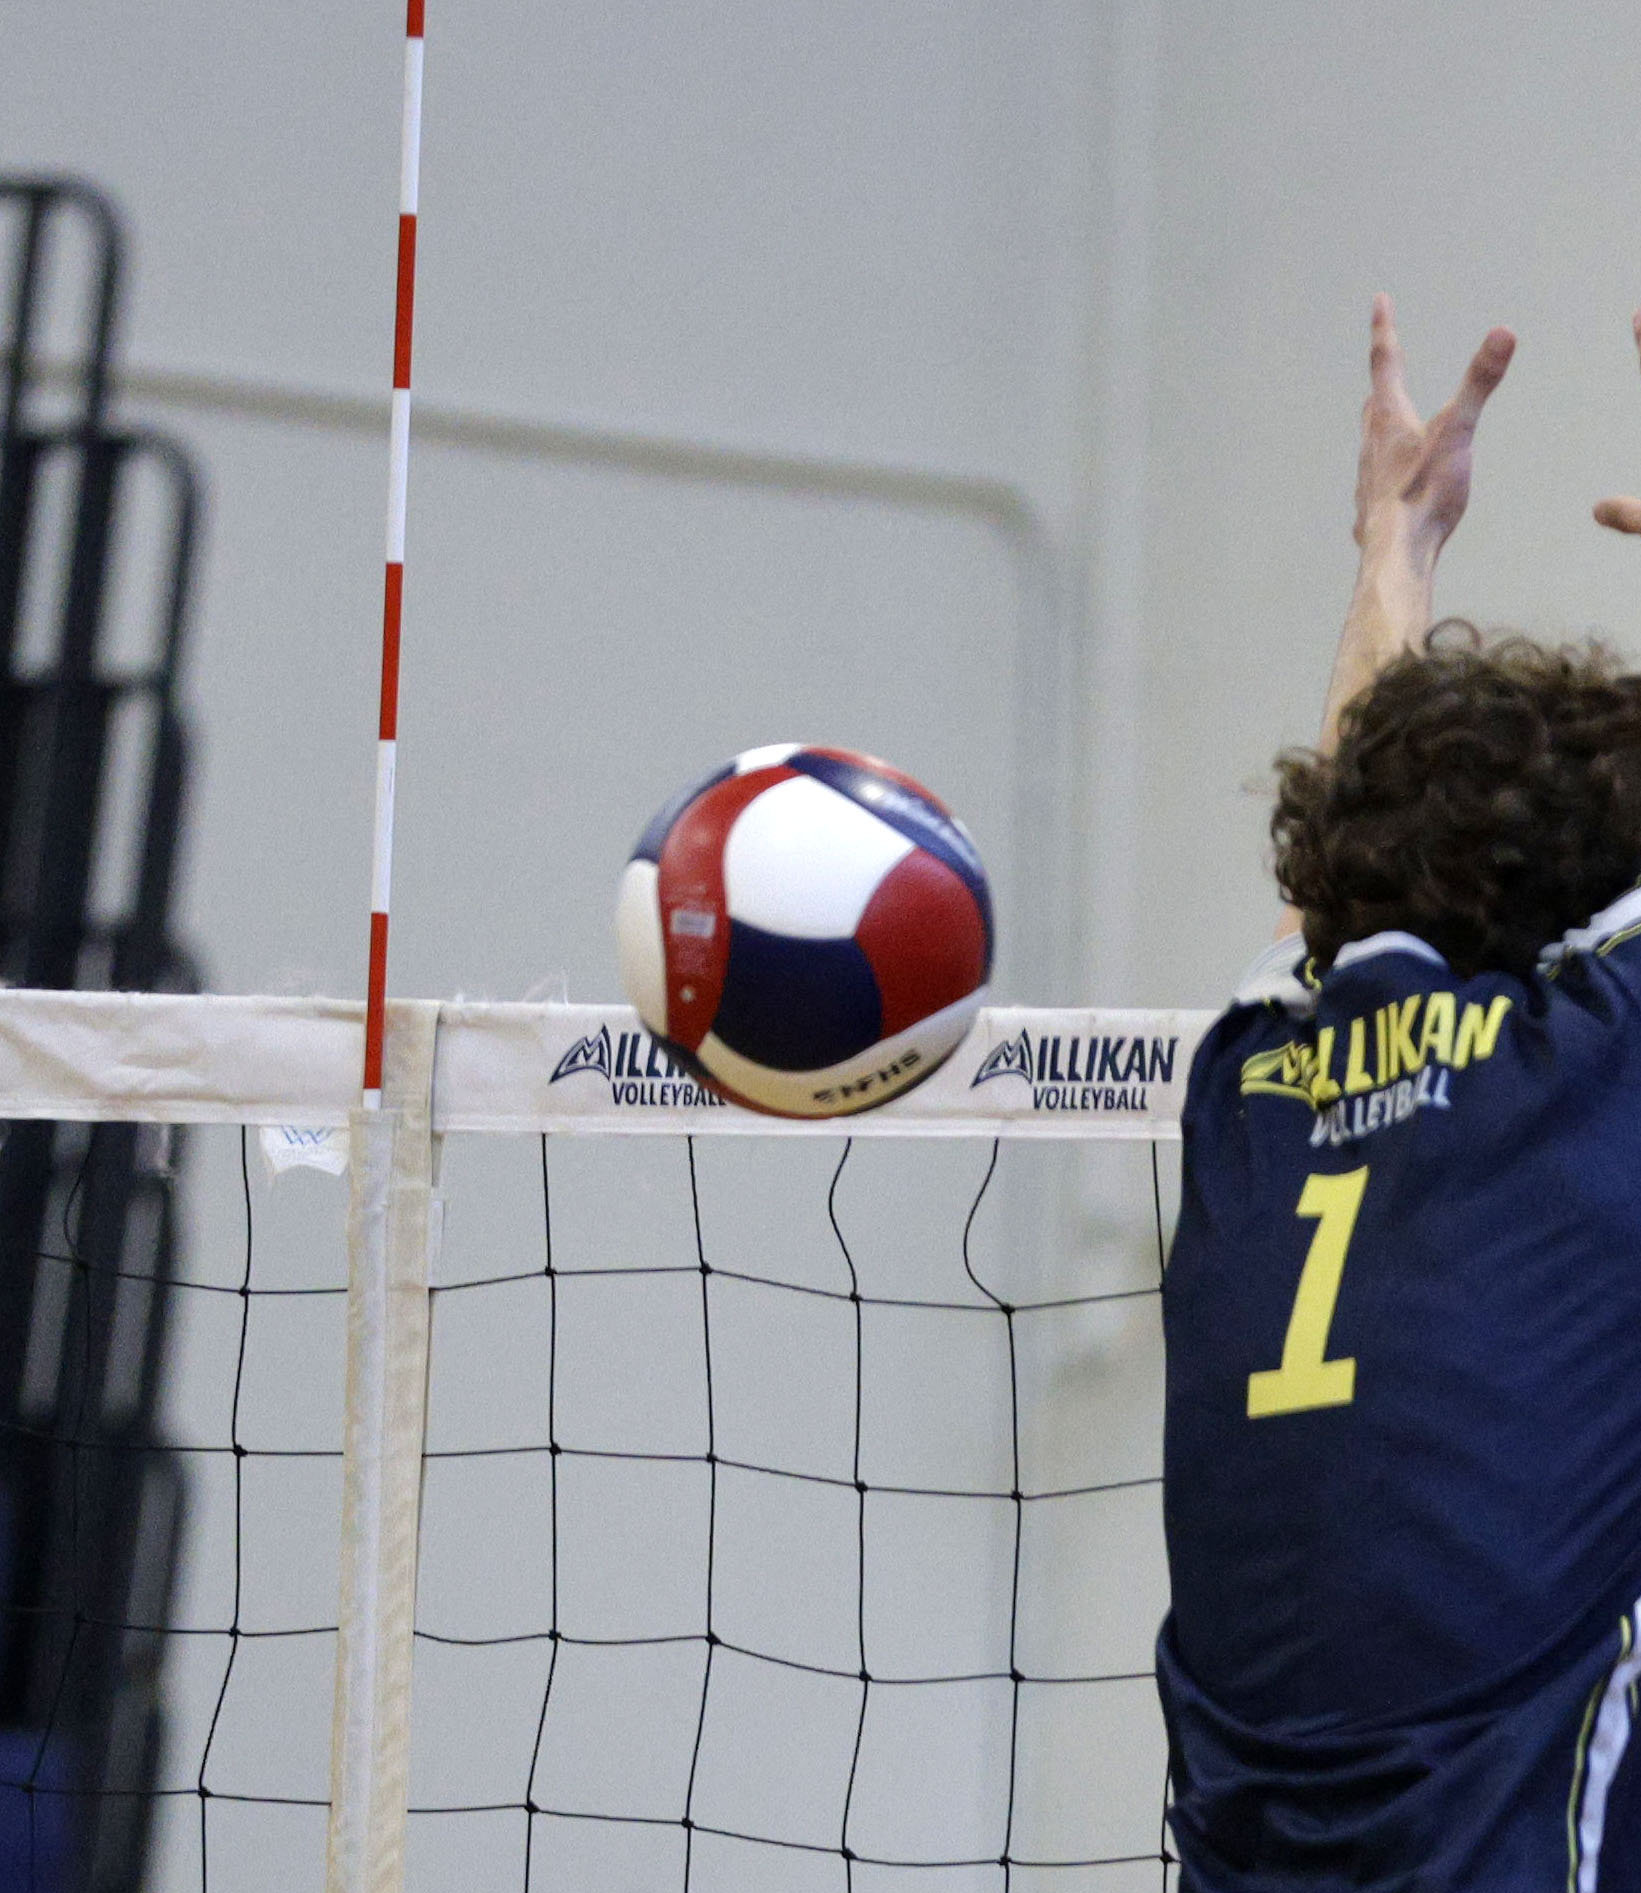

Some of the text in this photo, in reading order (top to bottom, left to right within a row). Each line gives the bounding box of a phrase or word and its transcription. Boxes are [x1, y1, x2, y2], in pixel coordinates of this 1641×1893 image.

[970, 1027, 1179, 1088] MILLIKAN
[1240, 991, 1513, 1110] MLLIKAN
[1032, 1086, 1148, 1112] VOLLEYBALL
[1309, 1065, 1452, 1148] VOLLEYBLL
[1246, 1164, 1370, 1420] 1
